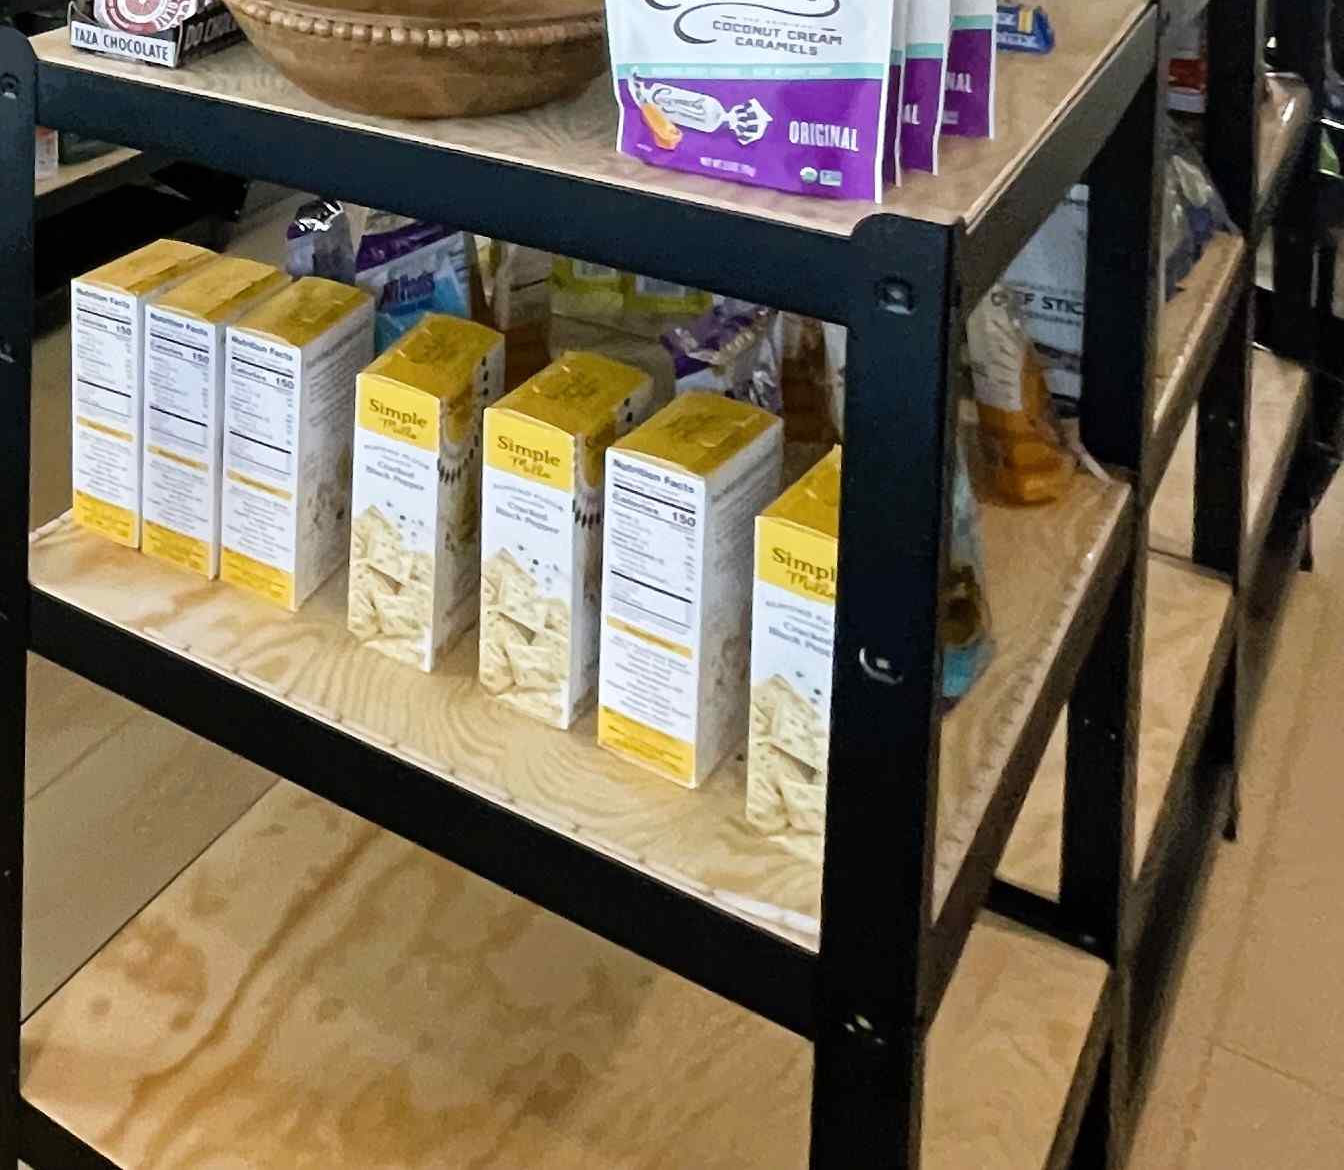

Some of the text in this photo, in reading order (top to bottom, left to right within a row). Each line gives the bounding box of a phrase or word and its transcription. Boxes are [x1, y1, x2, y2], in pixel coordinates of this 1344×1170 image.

[73, 26, 170, 61] TAZA CHOCOLATE
[712, 20, 843, 46] COCONUT CREAM
[734, 36, 819, 56] CARAMELS
[788, 120, 860, 153] ORIGINAL
[1041, 295, 1085, 316] STIC
[275, 376, 295, 390] 150
[368, 397, 428, 429] Simple
[496, 435, 561, 468] Simple
[613, 458, 696, 494] Nutrition Facts
[671, 511, 697, 528] 150
[771, 546, 836, 582] Simpl
